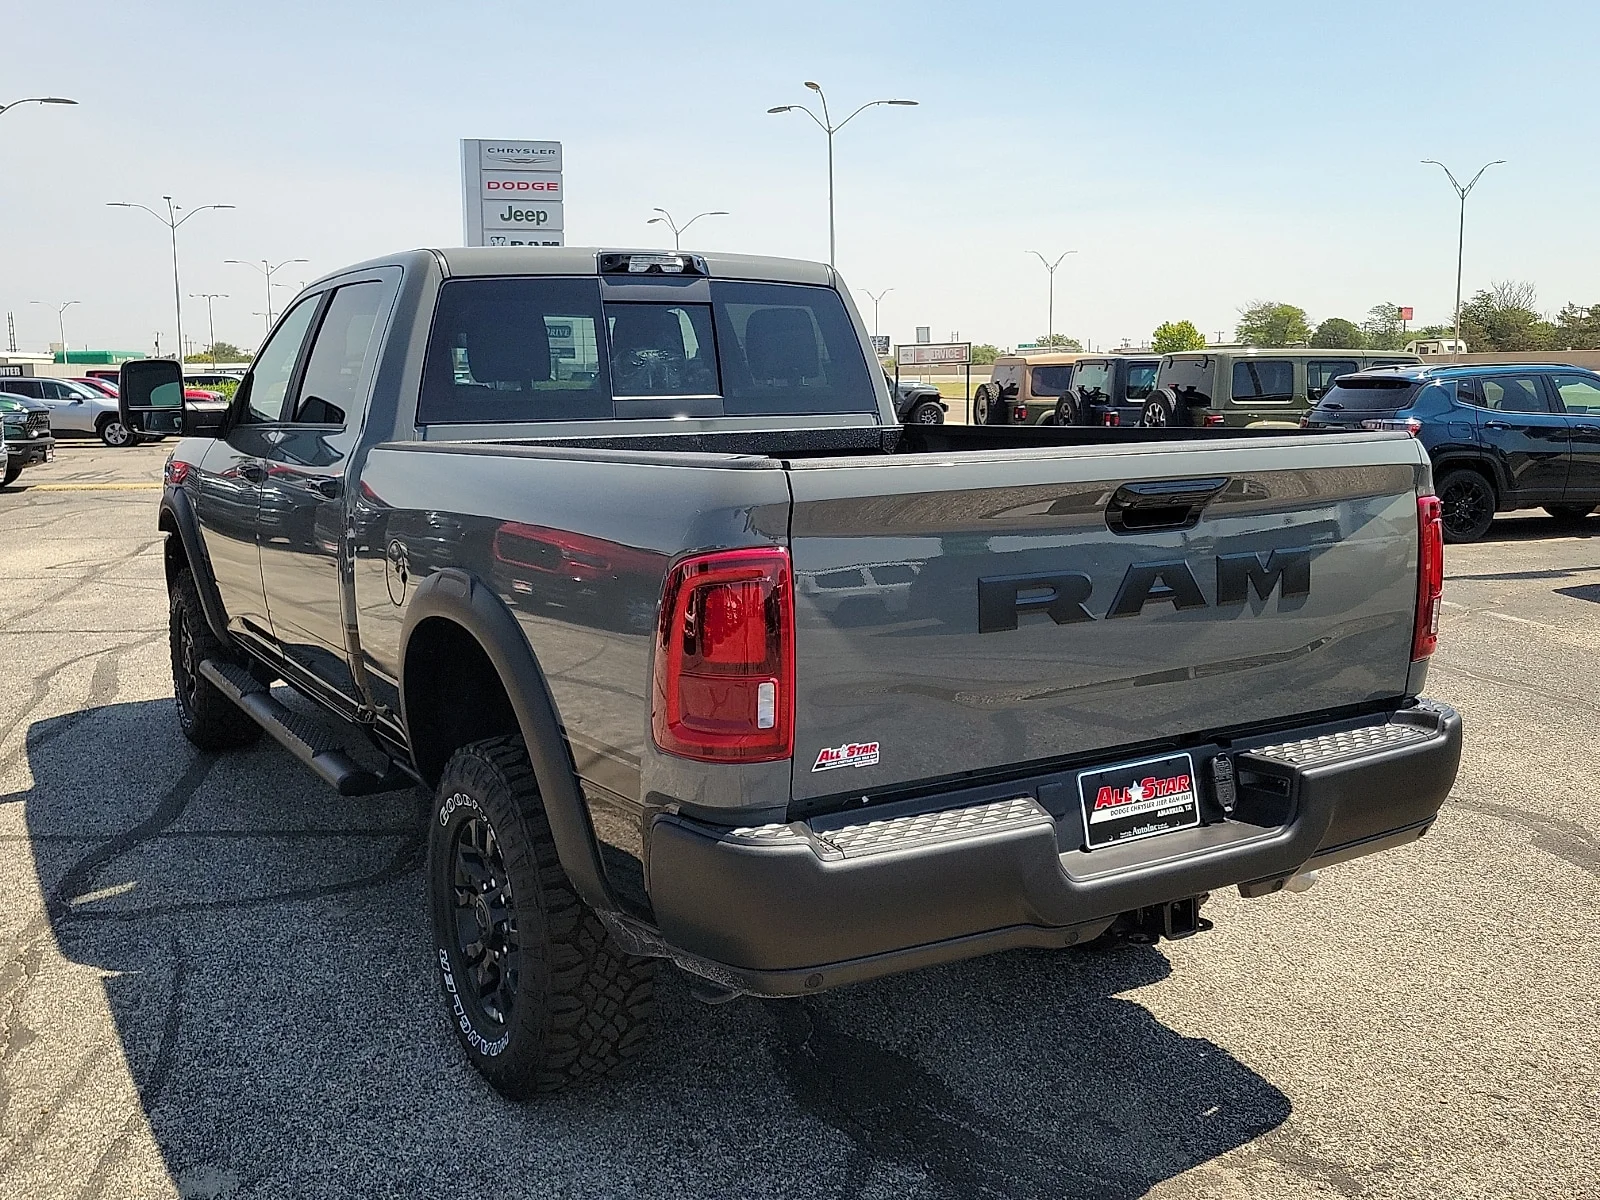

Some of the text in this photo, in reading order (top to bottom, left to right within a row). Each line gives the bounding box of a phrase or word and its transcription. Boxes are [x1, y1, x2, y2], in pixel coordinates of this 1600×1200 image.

[487, 147, 556, 155] CHRYSLER
[487, 181, 559, 191] DODGE
[500, 205, 548, 226] Jeep
[978, 546, 1311, 634] RAM
[818, 749, 841, 762] ALL
[847, 744, 878, 757] STAR
[1095, 774, 1190, 810] ALL STAR
[1110, 807, 1129, 816] DODGE
[1130, 802, 1155, 812] CHRYSLER
[439, 948, 510, 1057] WRANGLER
